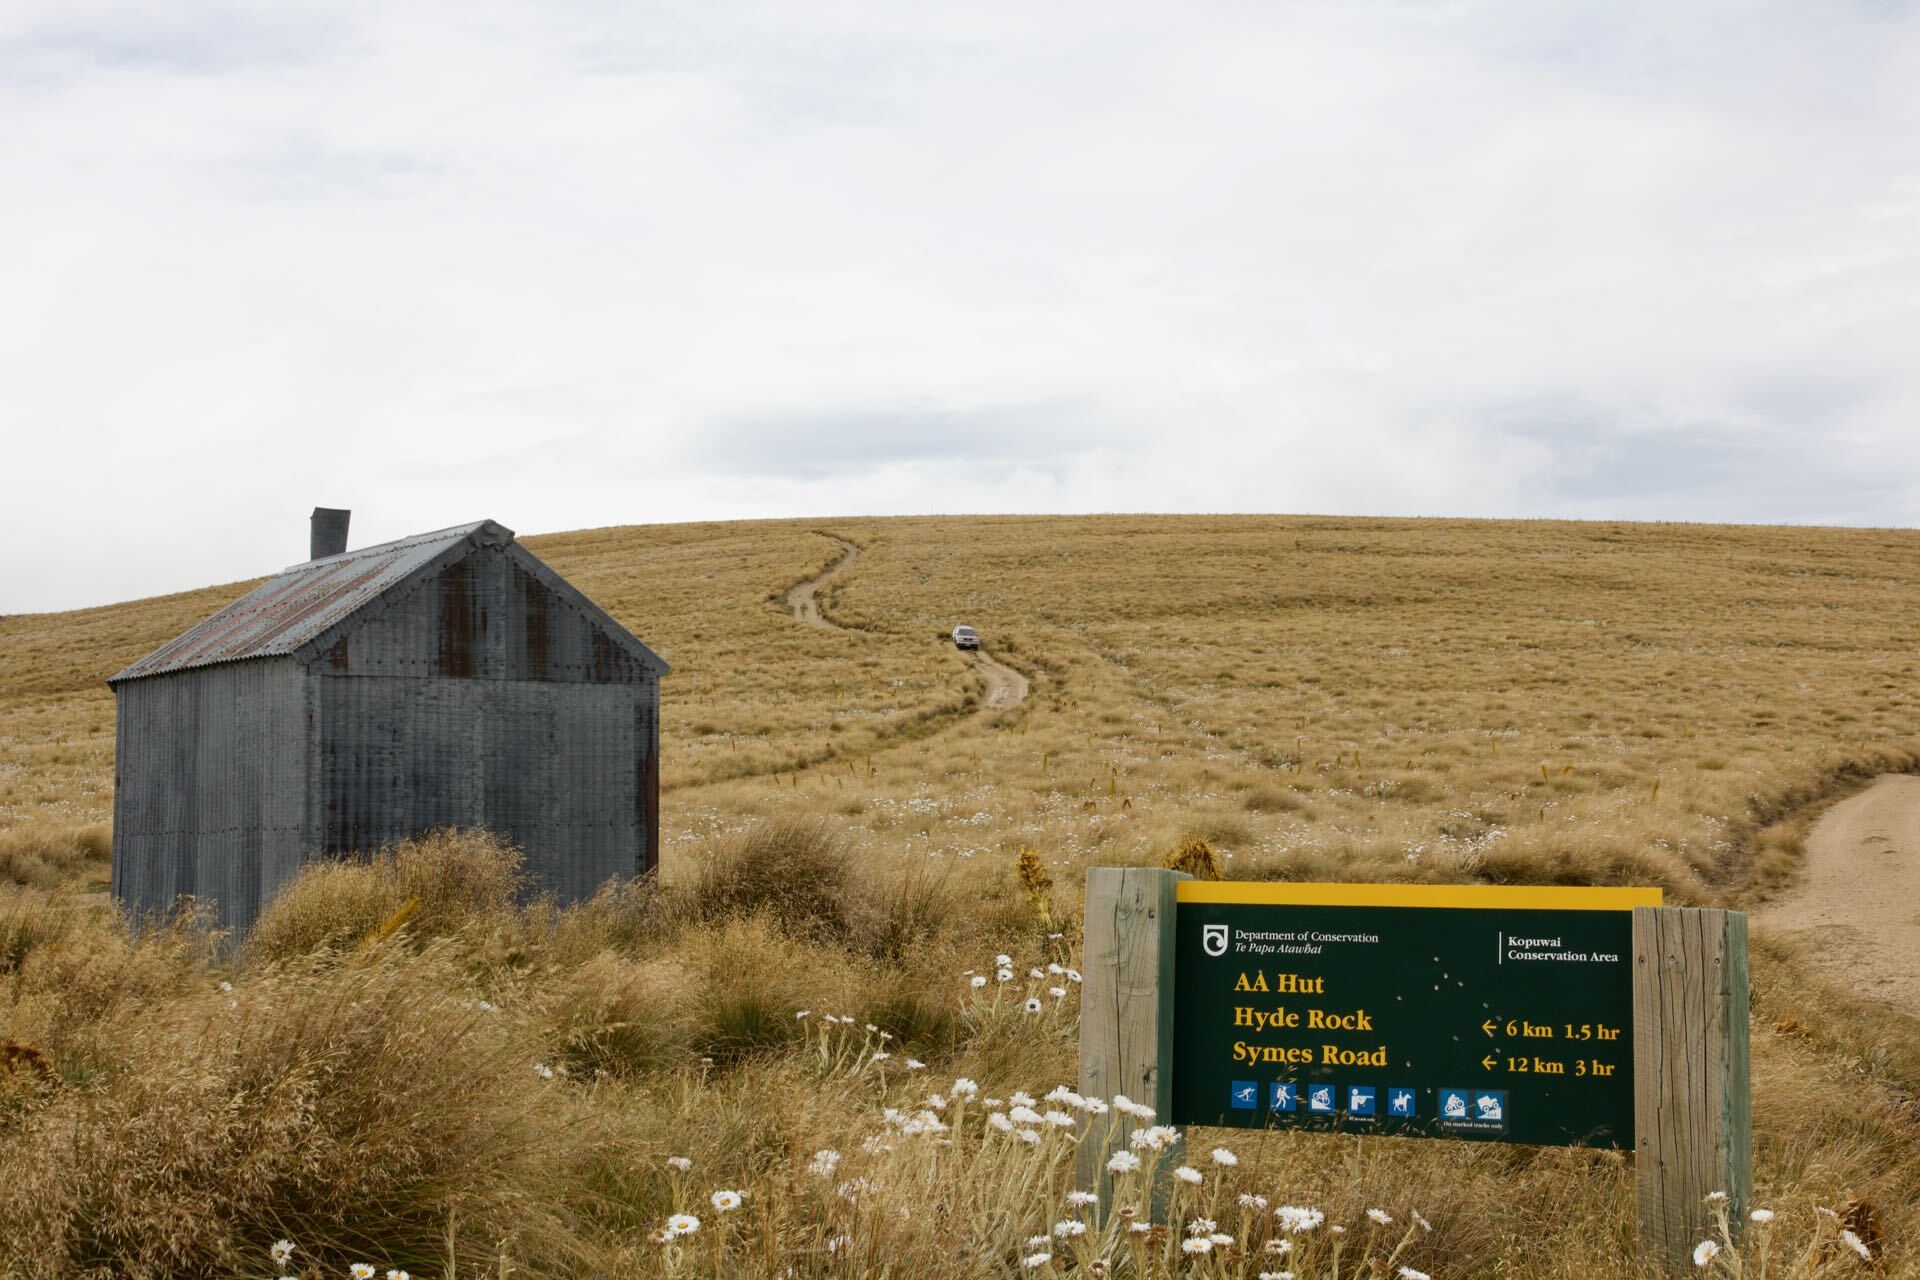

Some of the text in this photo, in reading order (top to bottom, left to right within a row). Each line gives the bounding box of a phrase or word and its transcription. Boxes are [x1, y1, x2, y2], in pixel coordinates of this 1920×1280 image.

[1235, 929, 1379, 943] Department of Conservation
[1508, 936, 1562, 949] Kopuwai
[1235, 942, 1322, 955] Te Papa Atawhai
[1507, 949, 1619, 962] Conservation Area
[1233, 971, 1325, 994] AA Hut
[1233, 1006, 1373, 1032] Hyde Rock
[1506, 1020, 1621, 1041] 6 km 1.5 hr
[1233, 1041, 1388, 1067] Symes Road
[1507, 1057, 1616, 1077] 12 km 3 hr
